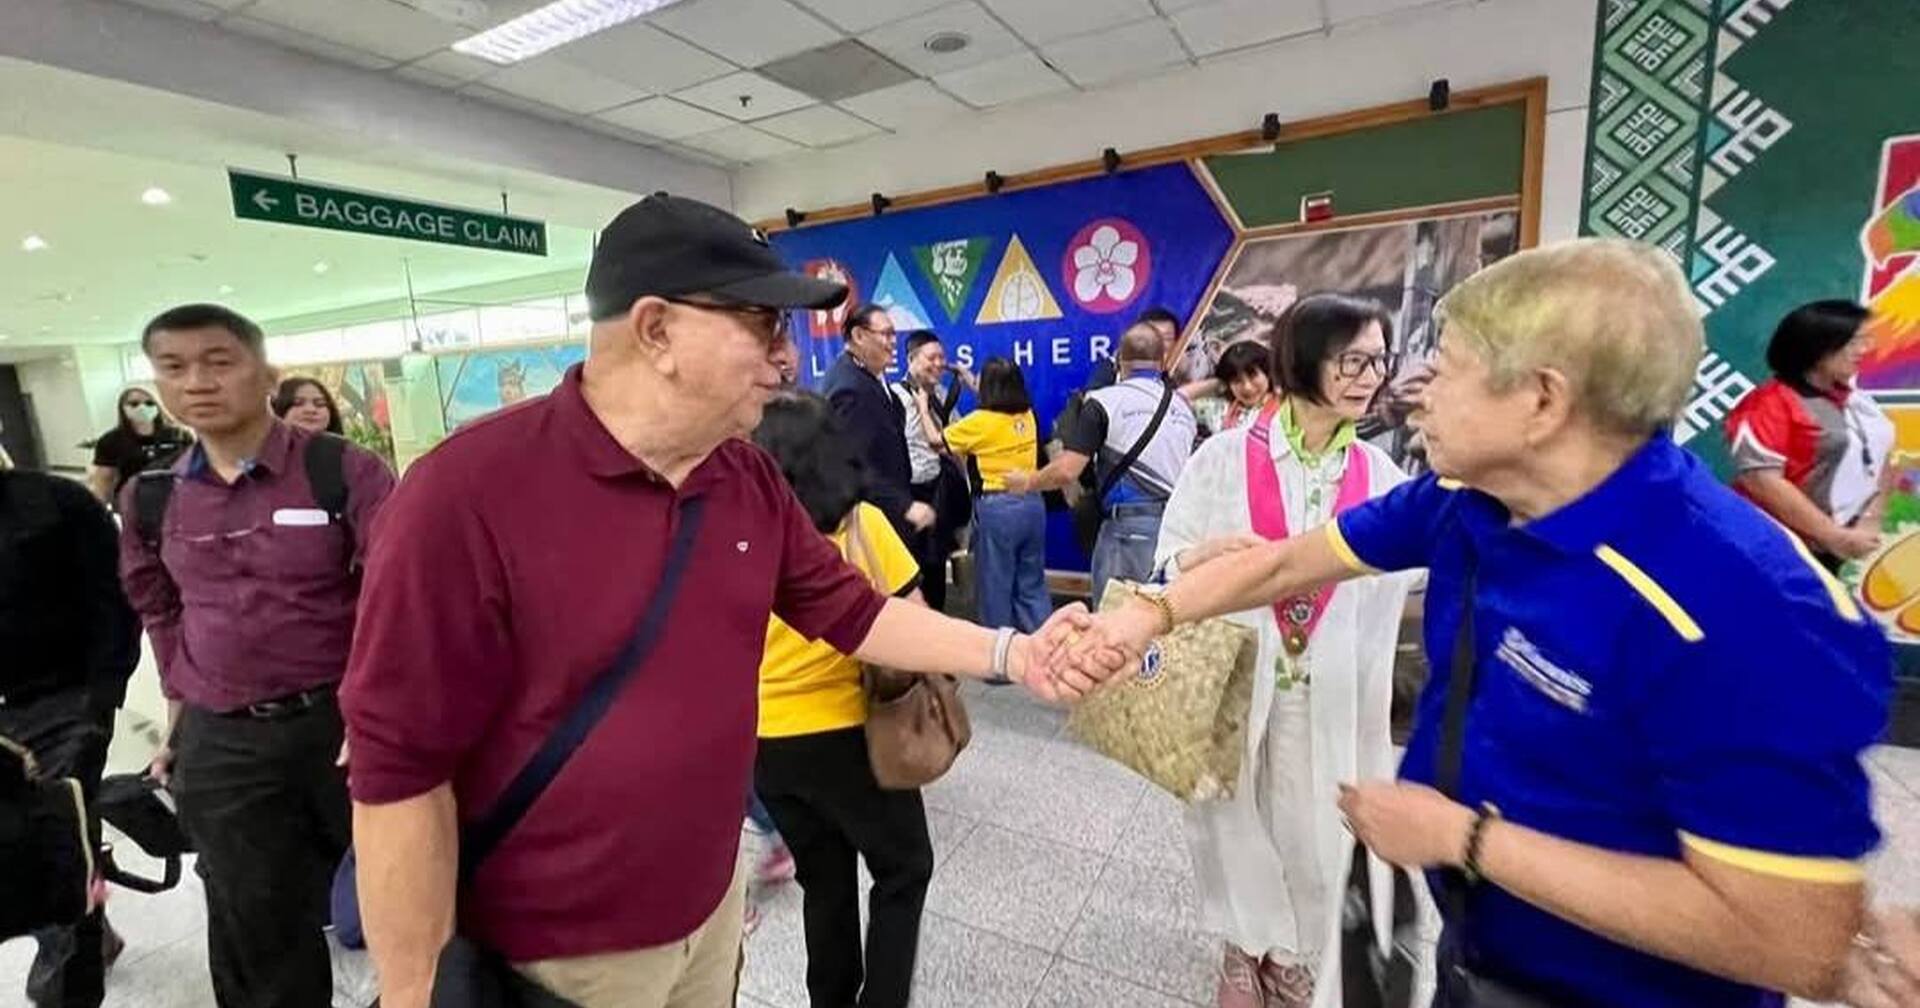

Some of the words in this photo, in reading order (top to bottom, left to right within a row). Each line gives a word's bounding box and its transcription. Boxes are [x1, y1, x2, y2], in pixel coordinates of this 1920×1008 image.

[295, 192, 456, 236] BAGGAGE
[463, 219, 538, 248] CLAIM
[1013, 335, 1115, 366] HER
